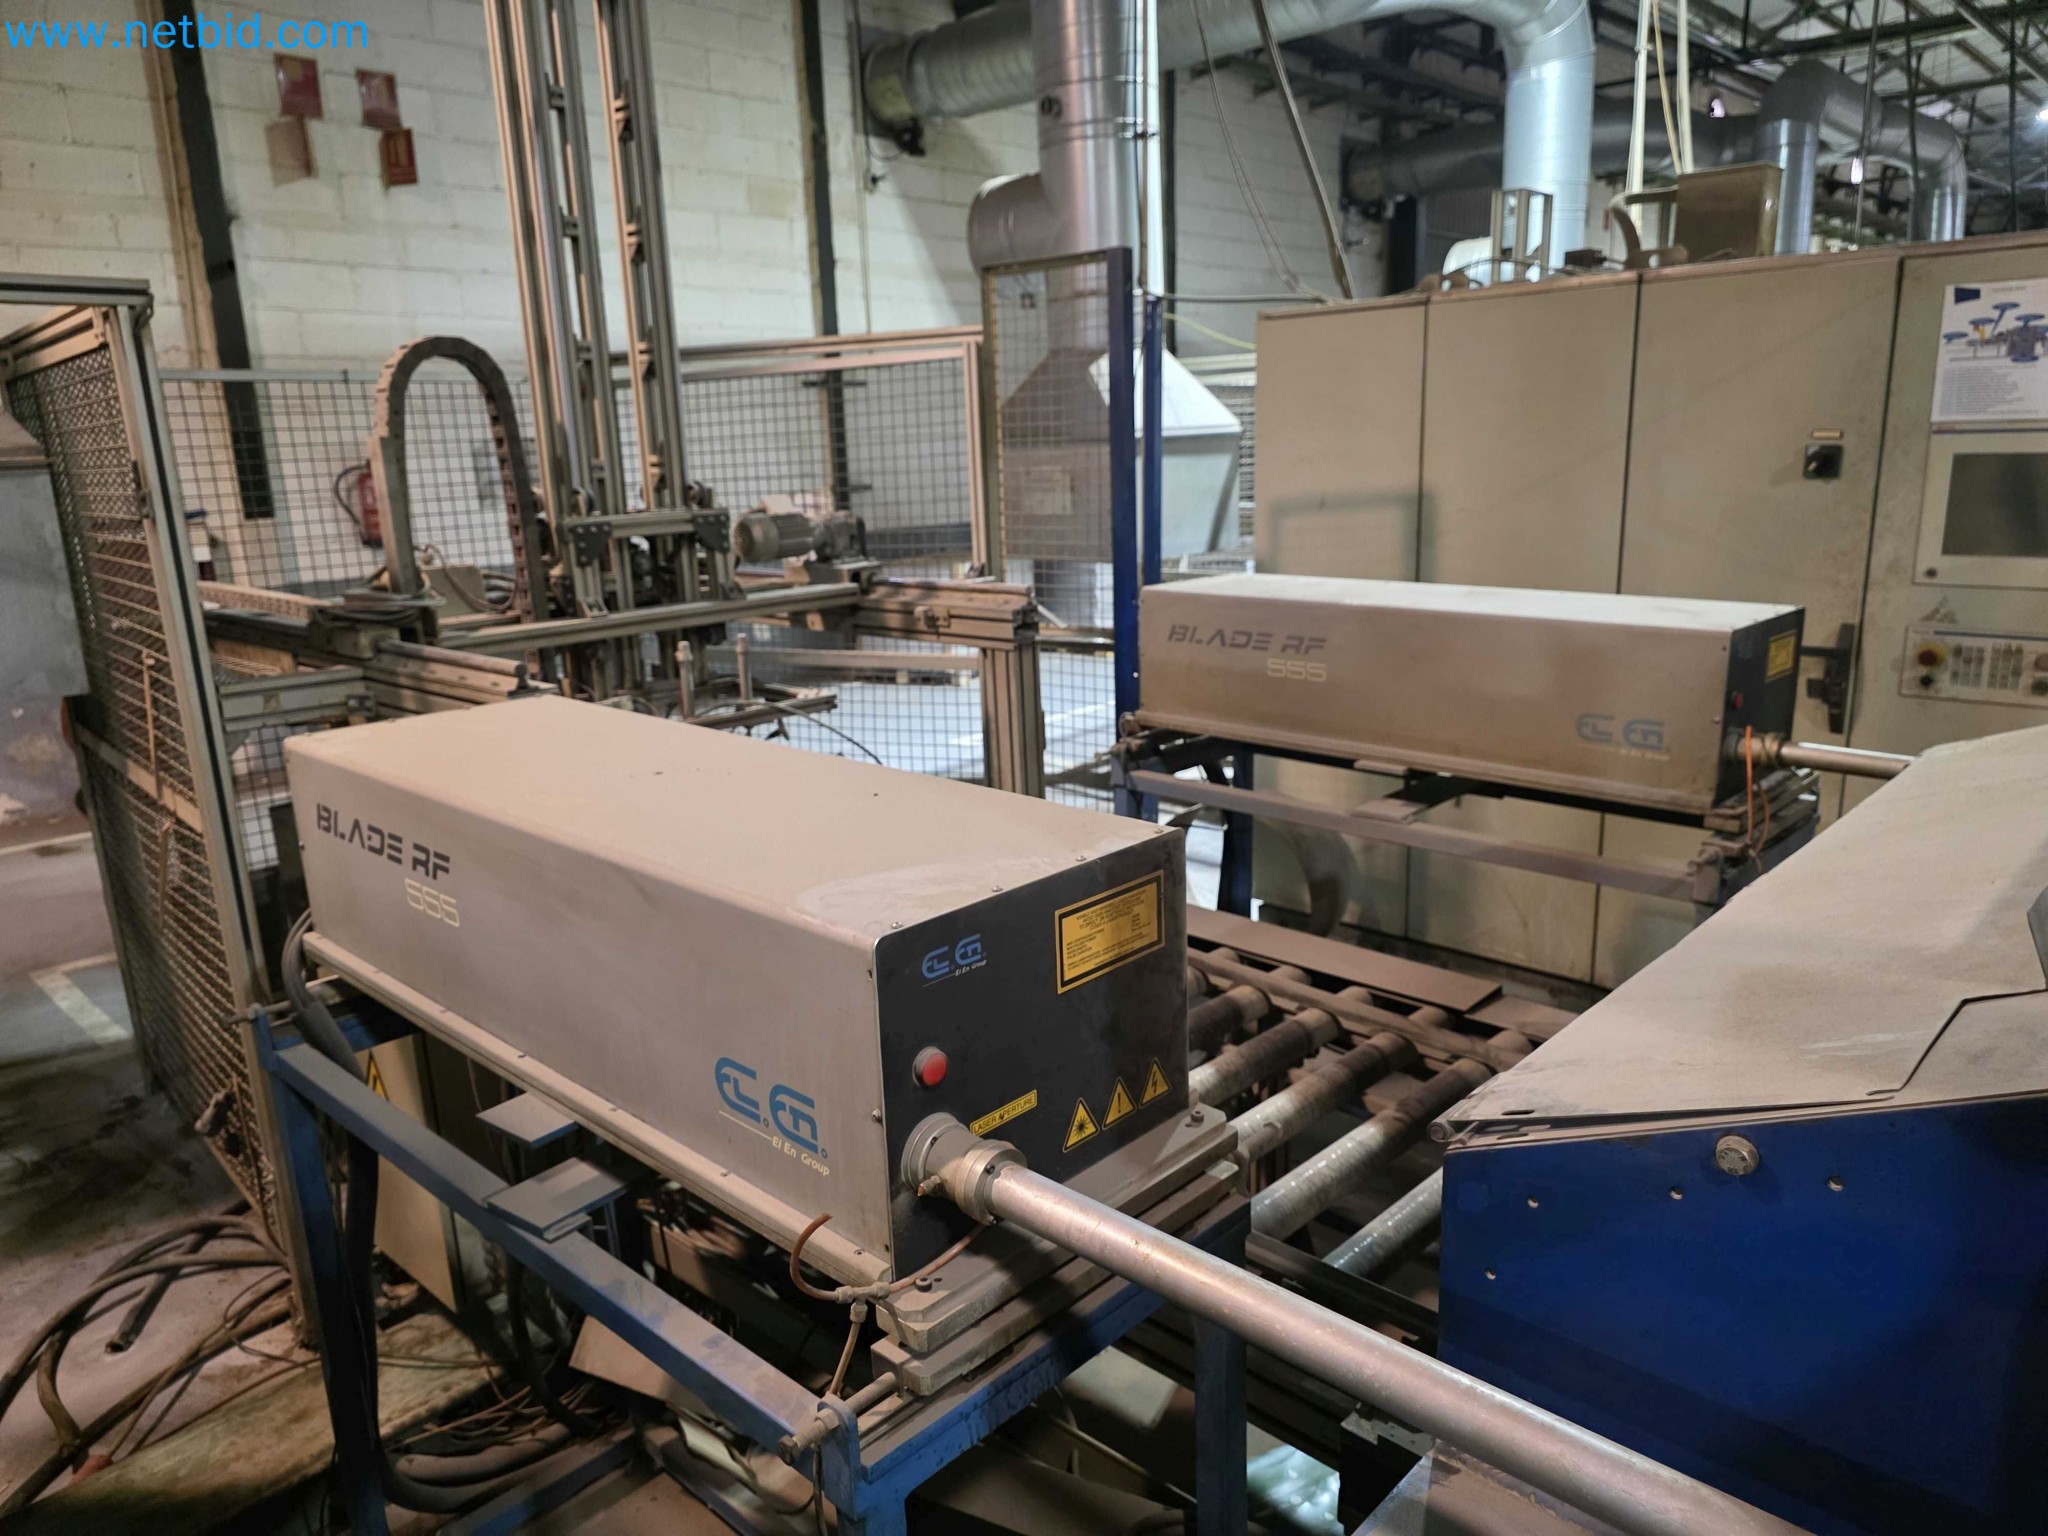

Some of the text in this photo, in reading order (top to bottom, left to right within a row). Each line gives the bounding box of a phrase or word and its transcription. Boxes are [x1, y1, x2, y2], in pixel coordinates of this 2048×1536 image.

[1168, 623, 1327, 656] BLADE RF
[317, 803, 450, 880] BLADE RF
[973, 1095, 1034, 1133] LASER APERTURE
[772, 1136, 830, 1177] El En Group
